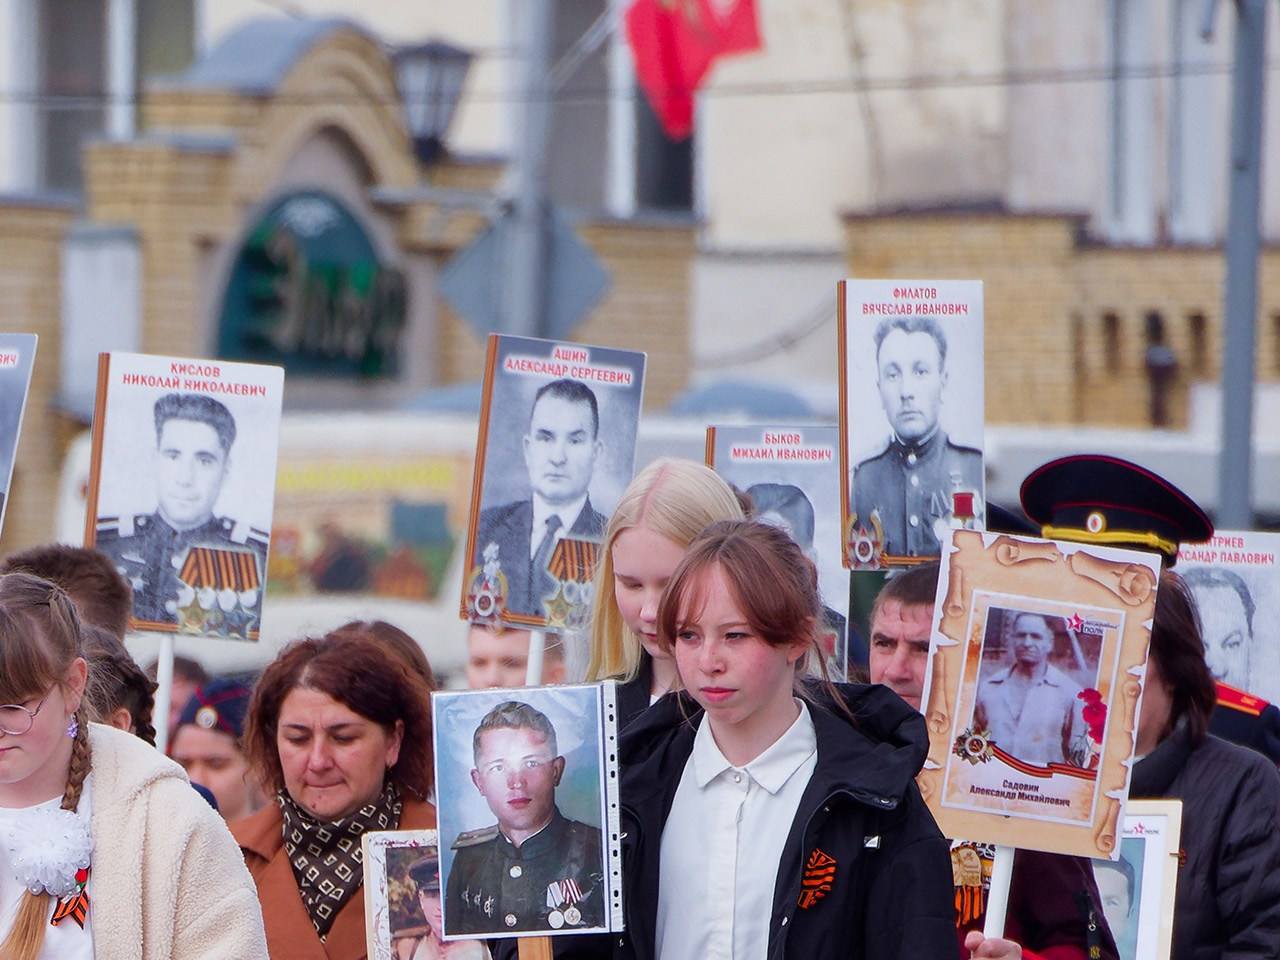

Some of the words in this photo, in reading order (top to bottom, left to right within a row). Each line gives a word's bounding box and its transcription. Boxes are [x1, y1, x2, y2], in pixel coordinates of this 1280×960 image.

[893, 288, 937, 299] ФИЛАТОВ
[862, 303, 912, 315] ВЯЧЕСЛАВ
[915, 304, 968, 315] ИВАНОВИЧ
[554, 348, 587, 362] АШИН
[170, 363, 221, 378] КИСЛОВ
[507, 358, 568, 377] АЛЕКСАНДР
[571, 366, 631, 384] СЕРГЕЕВИЧ
[123, 374, 180, 389] НИКОЛАЙ
[184, 378, 266, 397] НИКОЛАЕВИЧ
[765, 433, 800, 445] БЫКОВ
[732, 448, 774, 459] МИХАИЛ
[776, 449, 831, 460] ИВАНОВИЧ
[1177, 550, 1218, 564] КСАНДР
[1220, 551, 1274, 565] ПАВЛОВИЧ
[970, 785, 1016, 800] Александр
[1017, 791, 1071, 807] Михайлович
